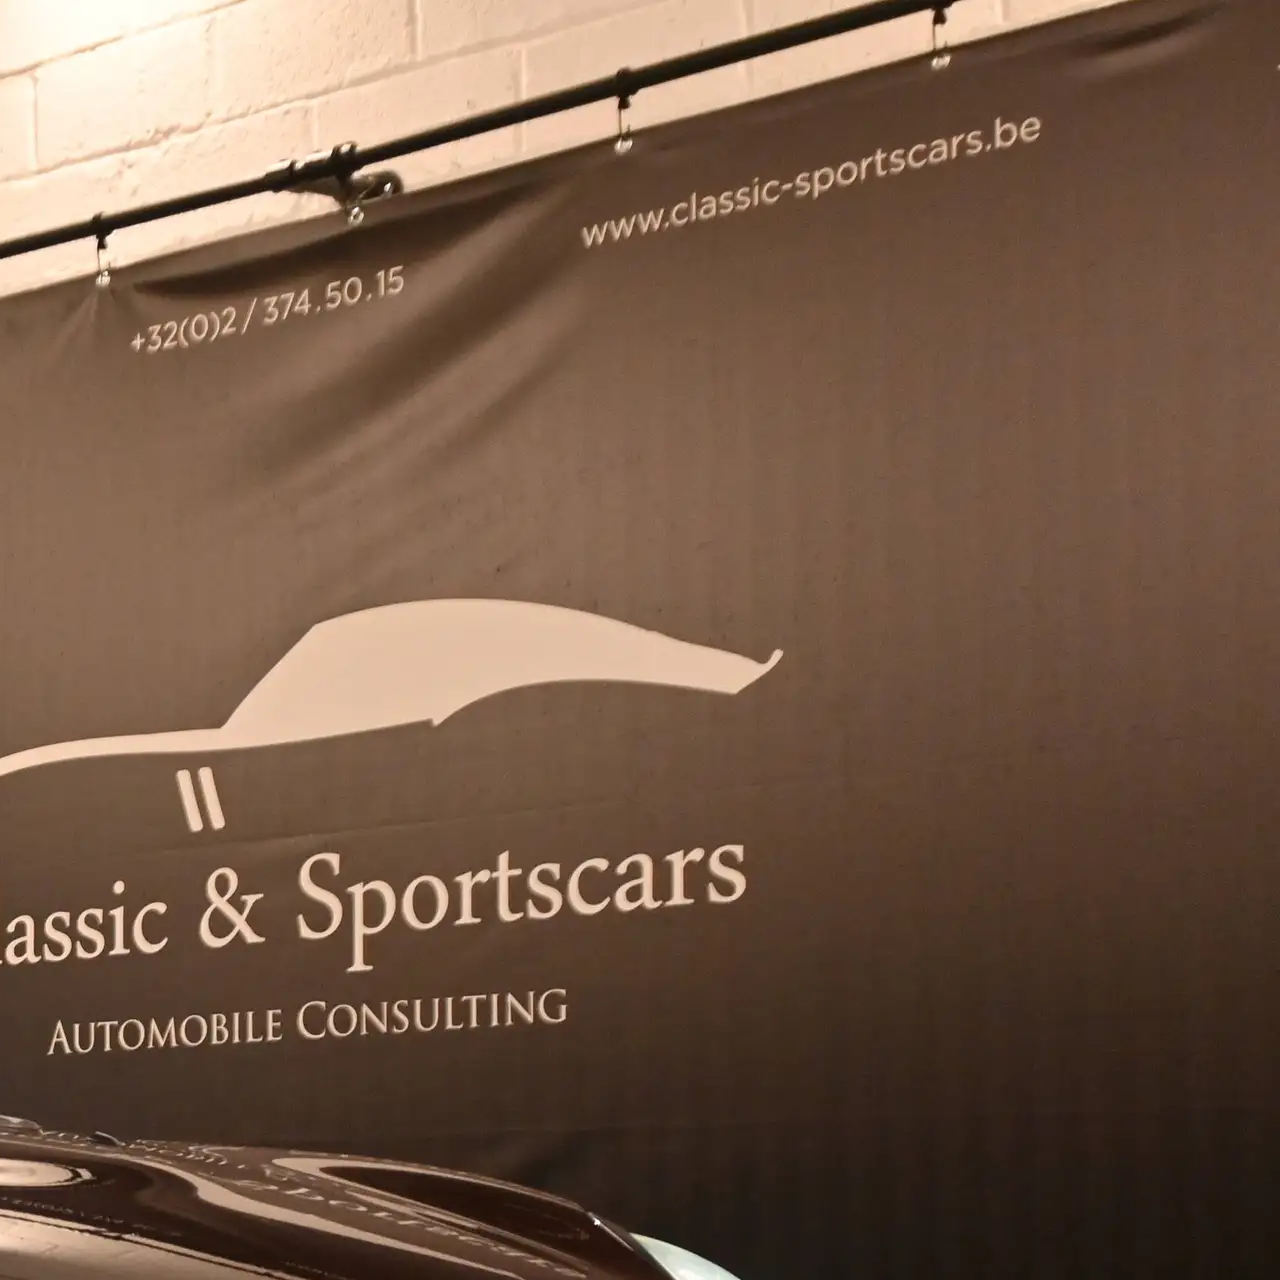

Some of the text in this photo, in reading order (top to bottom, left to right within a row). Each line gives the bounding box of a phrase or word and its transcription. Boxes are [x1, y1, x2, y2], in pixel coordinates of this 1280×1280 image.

[581, 113, 1042, 249] www.classic-sportscars.be
[130, 307, 237, 355] +32(0)2
[262, 265, 405, 326] 374.50.15
[199, 867, 265, 949] &
[297, 842, 747, 973] Sportscars
[46, 988, 568, 1056] AUTOMOBILE CONSULTING
